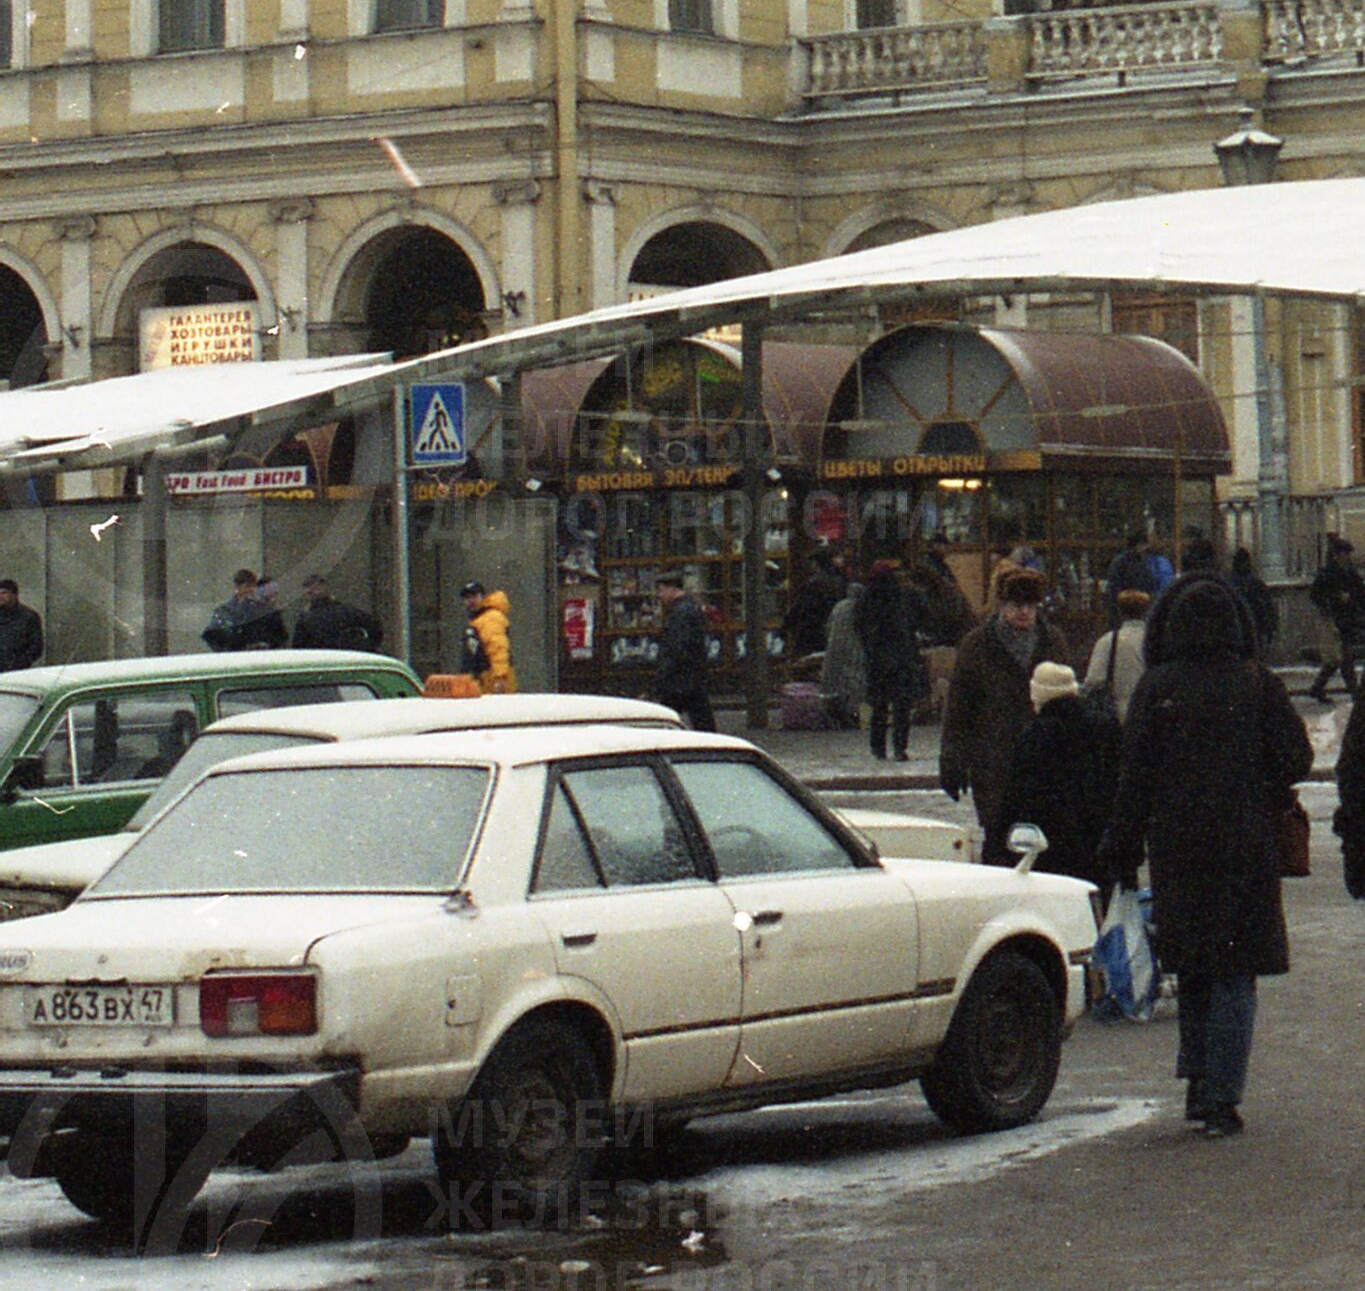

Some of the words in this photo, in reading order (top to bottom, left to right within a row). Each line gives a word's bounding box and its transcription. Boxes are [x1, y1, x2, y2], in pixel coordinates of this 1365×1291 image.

[170, 311, 252, 326] ГАЛАНТЕРЕЯ
[171, 325, 252, 339] ХОЗТОВАРЫ
[171, 338, 252, 352] ИГРУШКИ
[171, 351, 252, 365] КАНЦТОВАРЫ
[824, 460, 881, 478] ЦВЕТЫ
[892, 454, 985, 474] ОТКРЫТКИ
[253, 470, 302, 486] БИСТРО
[576, 471, 654, 492] БЫТОВАЯ
[140, 989, 163, 1012] 47
